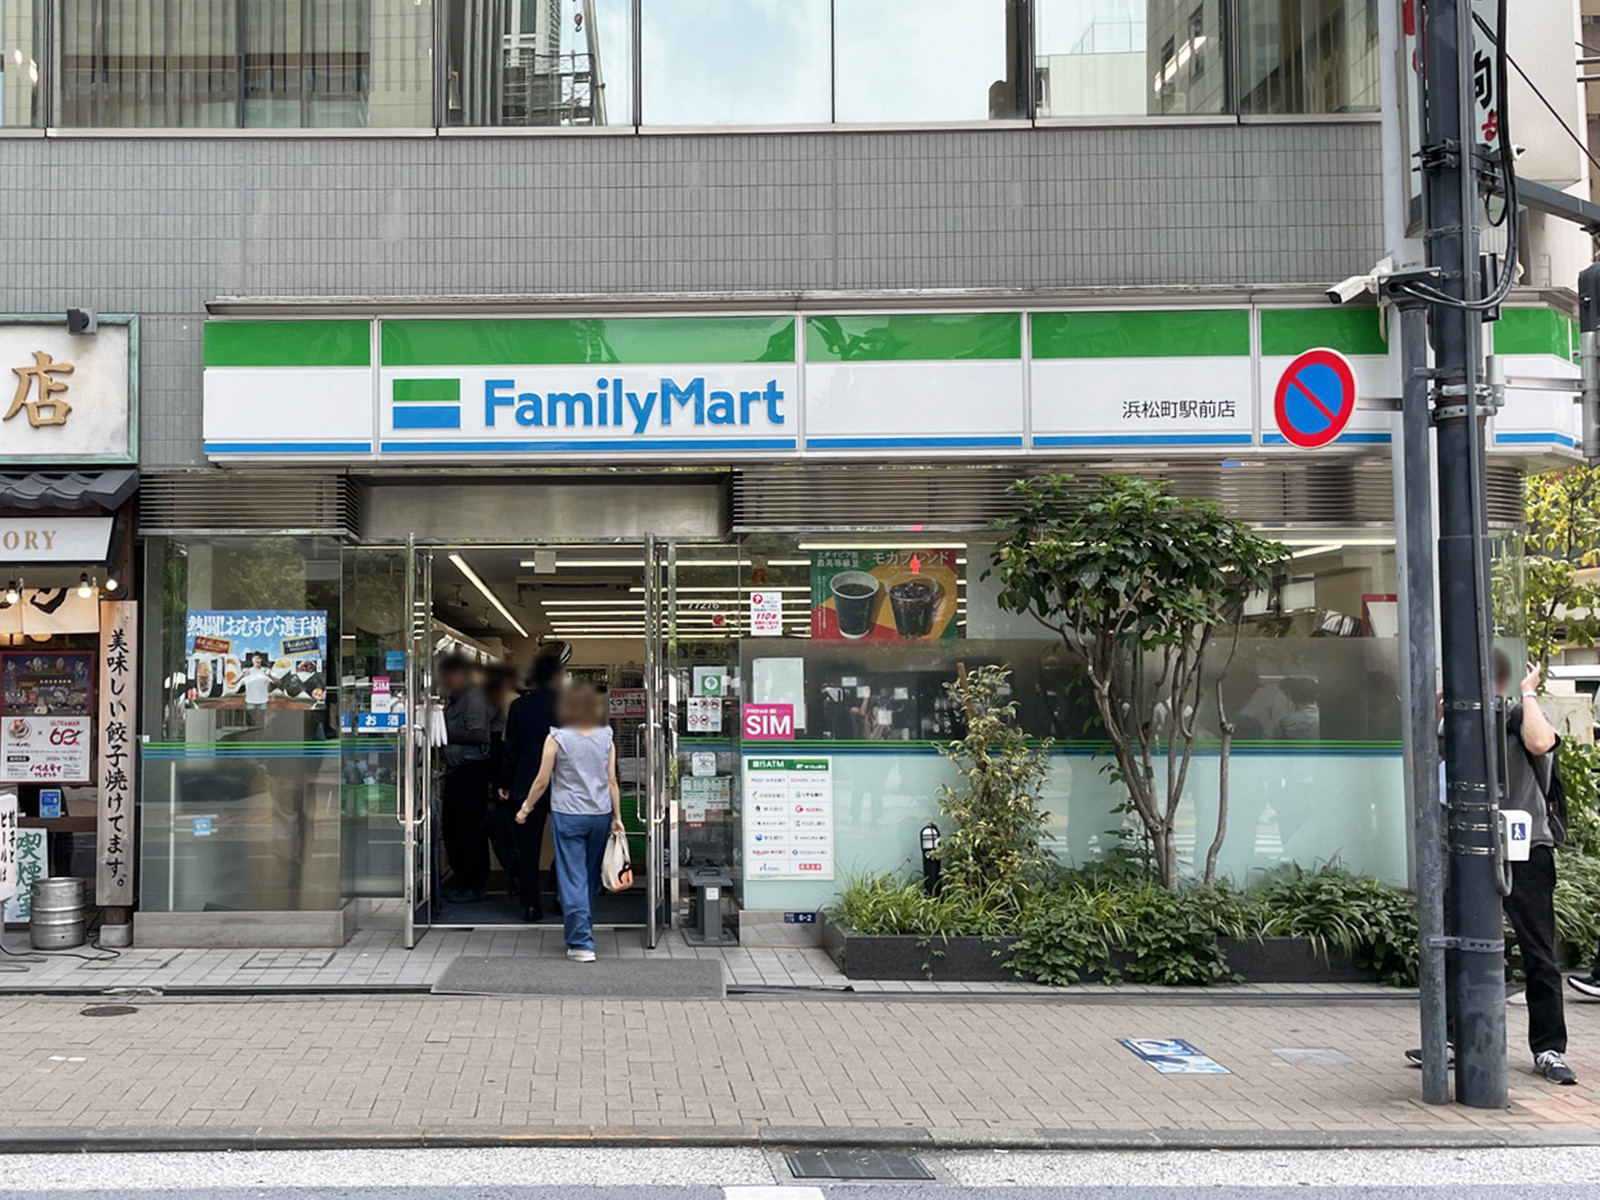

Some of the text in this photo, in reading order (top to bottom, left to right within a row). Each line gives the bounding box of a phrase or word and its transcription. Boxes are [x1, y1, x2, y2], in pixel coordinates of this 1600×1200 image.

[2, 350, 75, 429] 店
[484, 377, 785, 434] FamilyMart
[1122, 400, 1236, 418] 浜松町駅前店
[2, 530, 57, 550] ORY
[372, 681, 391, 692] SIM
[365, 714, 399, 726] お酒
[746, 715, 791, 735] SIM
[105, 628, 129, 887] 美味しい餃子焼けてます。
